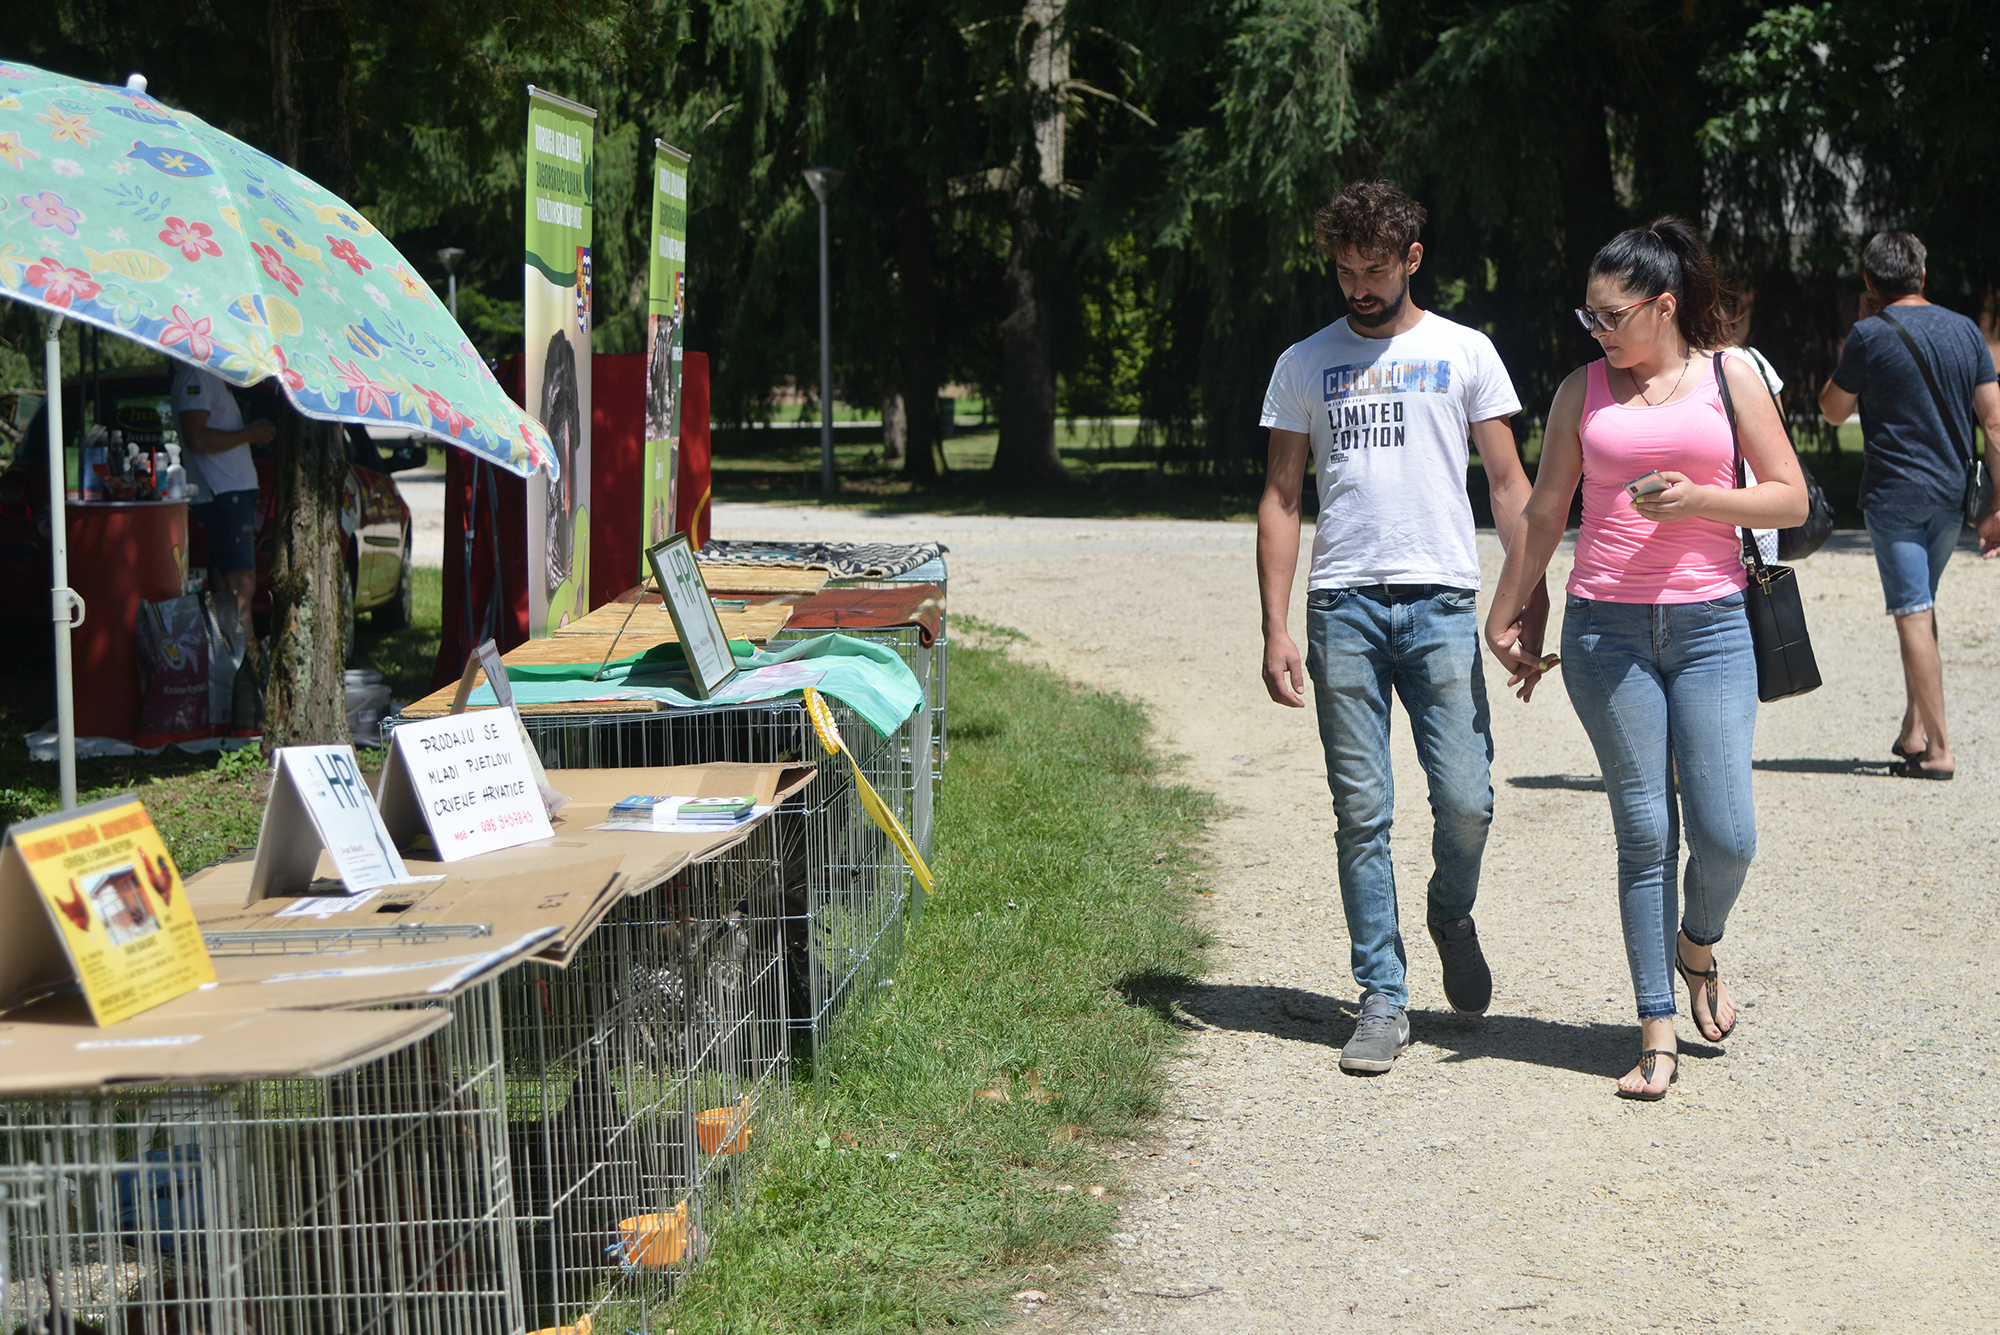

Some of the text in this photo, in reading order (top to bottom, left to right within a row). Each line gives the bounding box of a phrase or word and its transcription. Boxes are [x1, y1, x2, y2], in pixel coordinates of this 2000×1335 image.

[1328, 401, 1404, 430] LIMITED
[1331, 426, 1405, 453] EDITION
[420, 723, 500, 754] PRODAJU SE
[428, 752, 513, 785] MLADI PJETLOVI
[434, 781, 525, 817] CRVENE HRVATICE
[481, 818, 497, 832] 098
